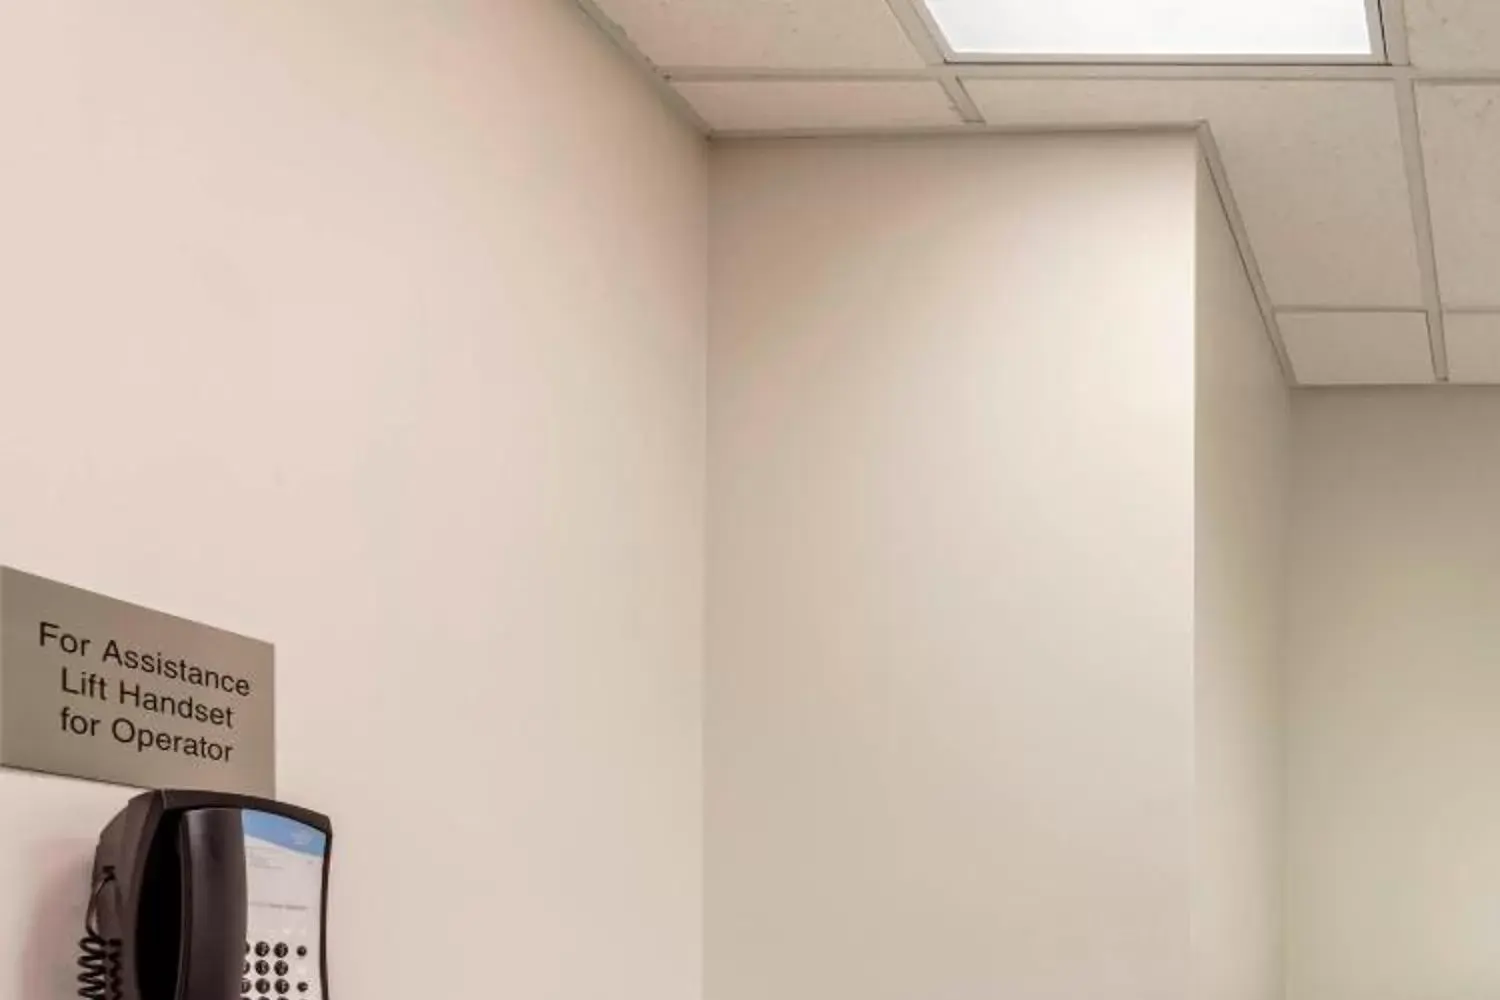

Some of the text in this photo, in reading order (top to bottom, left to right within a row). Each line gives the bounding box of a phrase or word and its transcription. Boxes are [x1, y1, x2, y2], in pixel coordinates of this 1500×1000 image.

[39, 621, 250, 697] For Assistance
[61, 666, 234, 729] Lift Handset
[60, 706, 234, 763] for Operator
